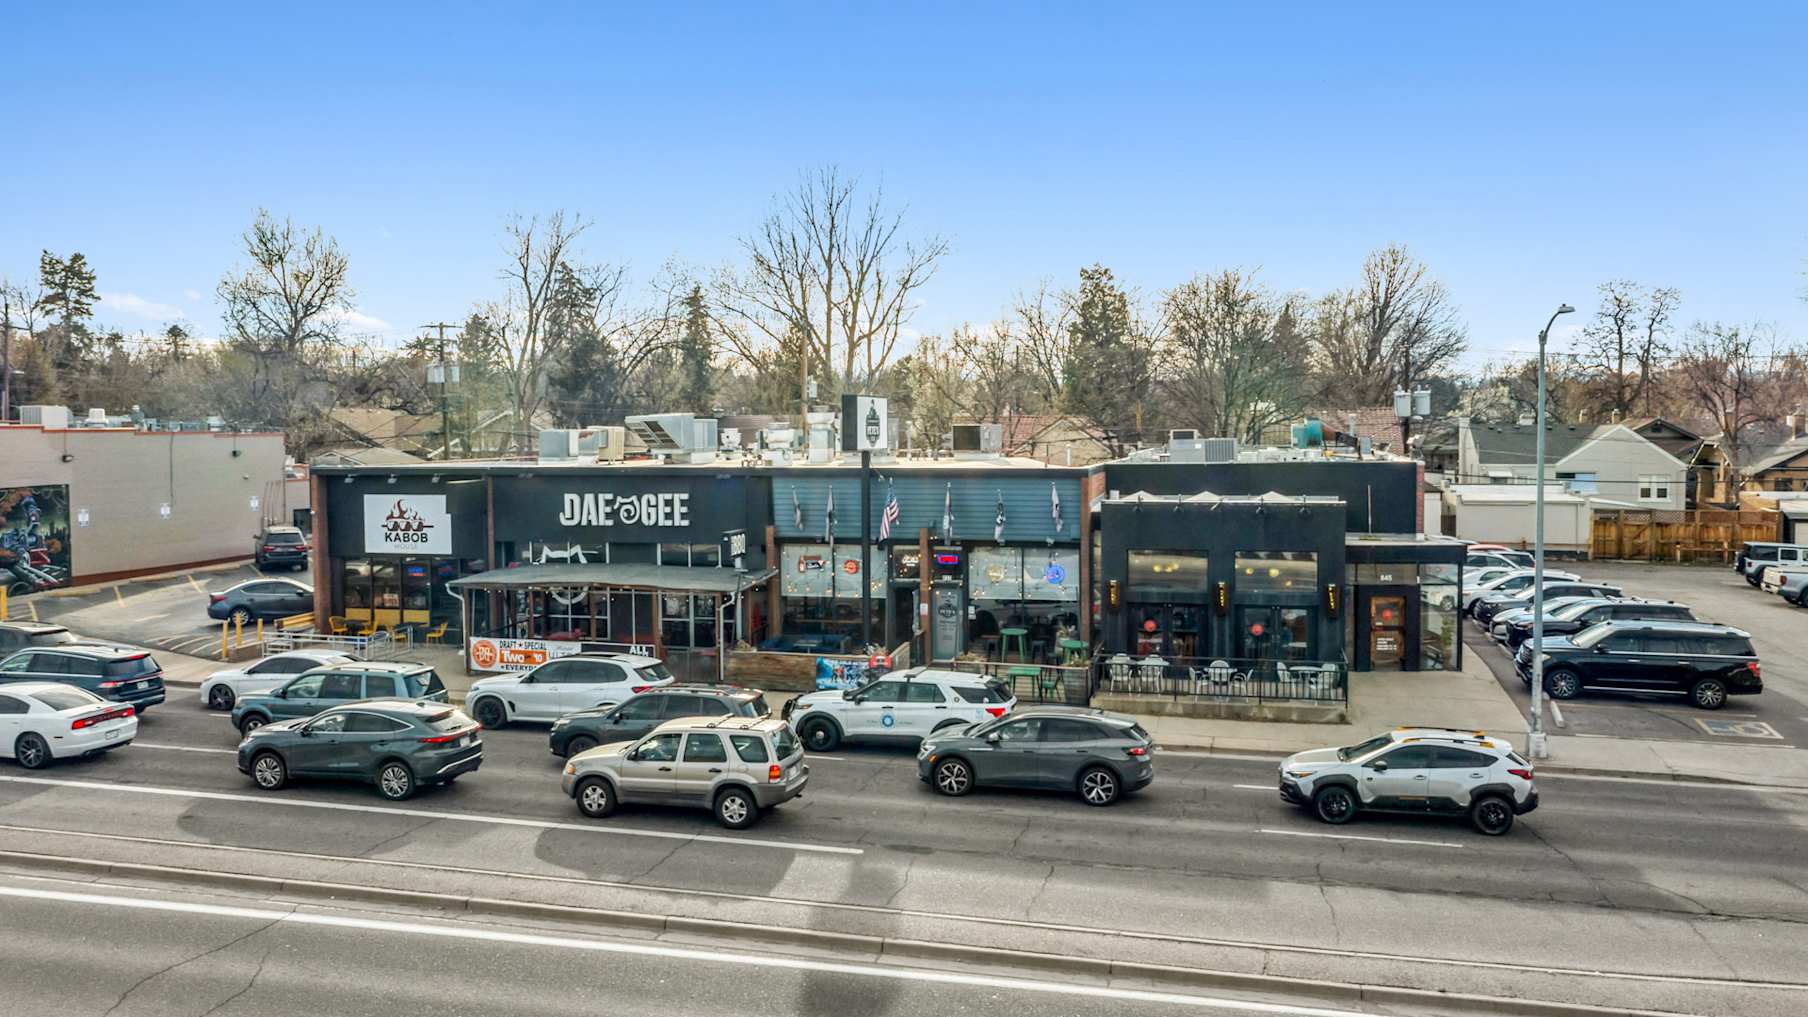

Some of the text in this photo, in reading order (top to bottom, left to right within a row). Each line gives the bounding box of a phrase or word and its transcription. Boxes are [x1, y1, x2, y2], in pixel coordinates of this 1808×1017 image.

[559, 493, 690, 526] DAE GEE
[384, 532, 428, 543] KABOB
[499, 640, 547, 650] DRAFT SPECIAL
